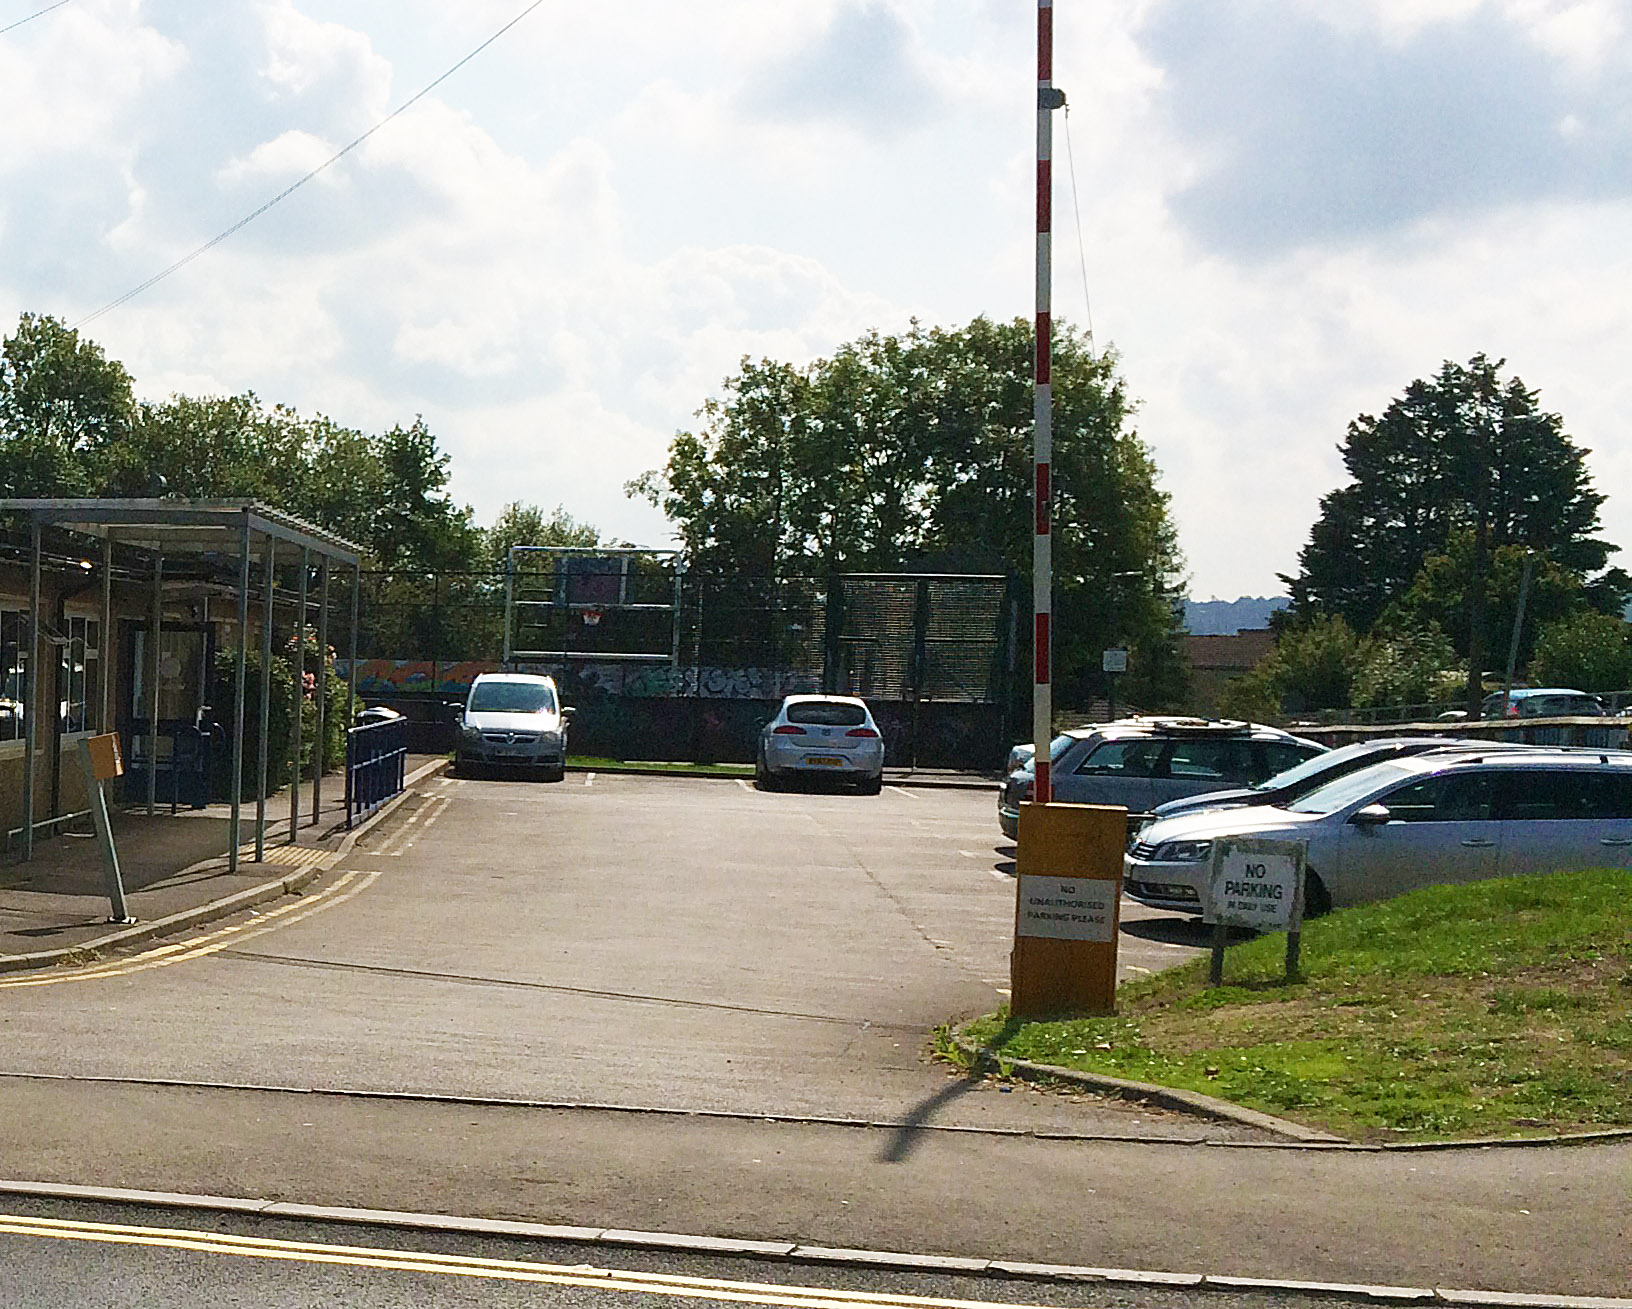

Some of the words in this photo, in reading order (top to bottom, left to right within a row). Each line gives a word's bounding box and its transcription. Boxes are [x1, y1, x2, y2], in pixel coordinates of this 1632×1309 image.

[1245, 864, 1266, 879] NO
[1060, 885, 1076, 894] NO
[1224, 880, 1283, 900] PARKING
[1029, 897, 1105, 910] UNAUTHORISED
[1027, 911, 1070, 921] PARKING
[1071, 914, 1106, 924] PLEASE
